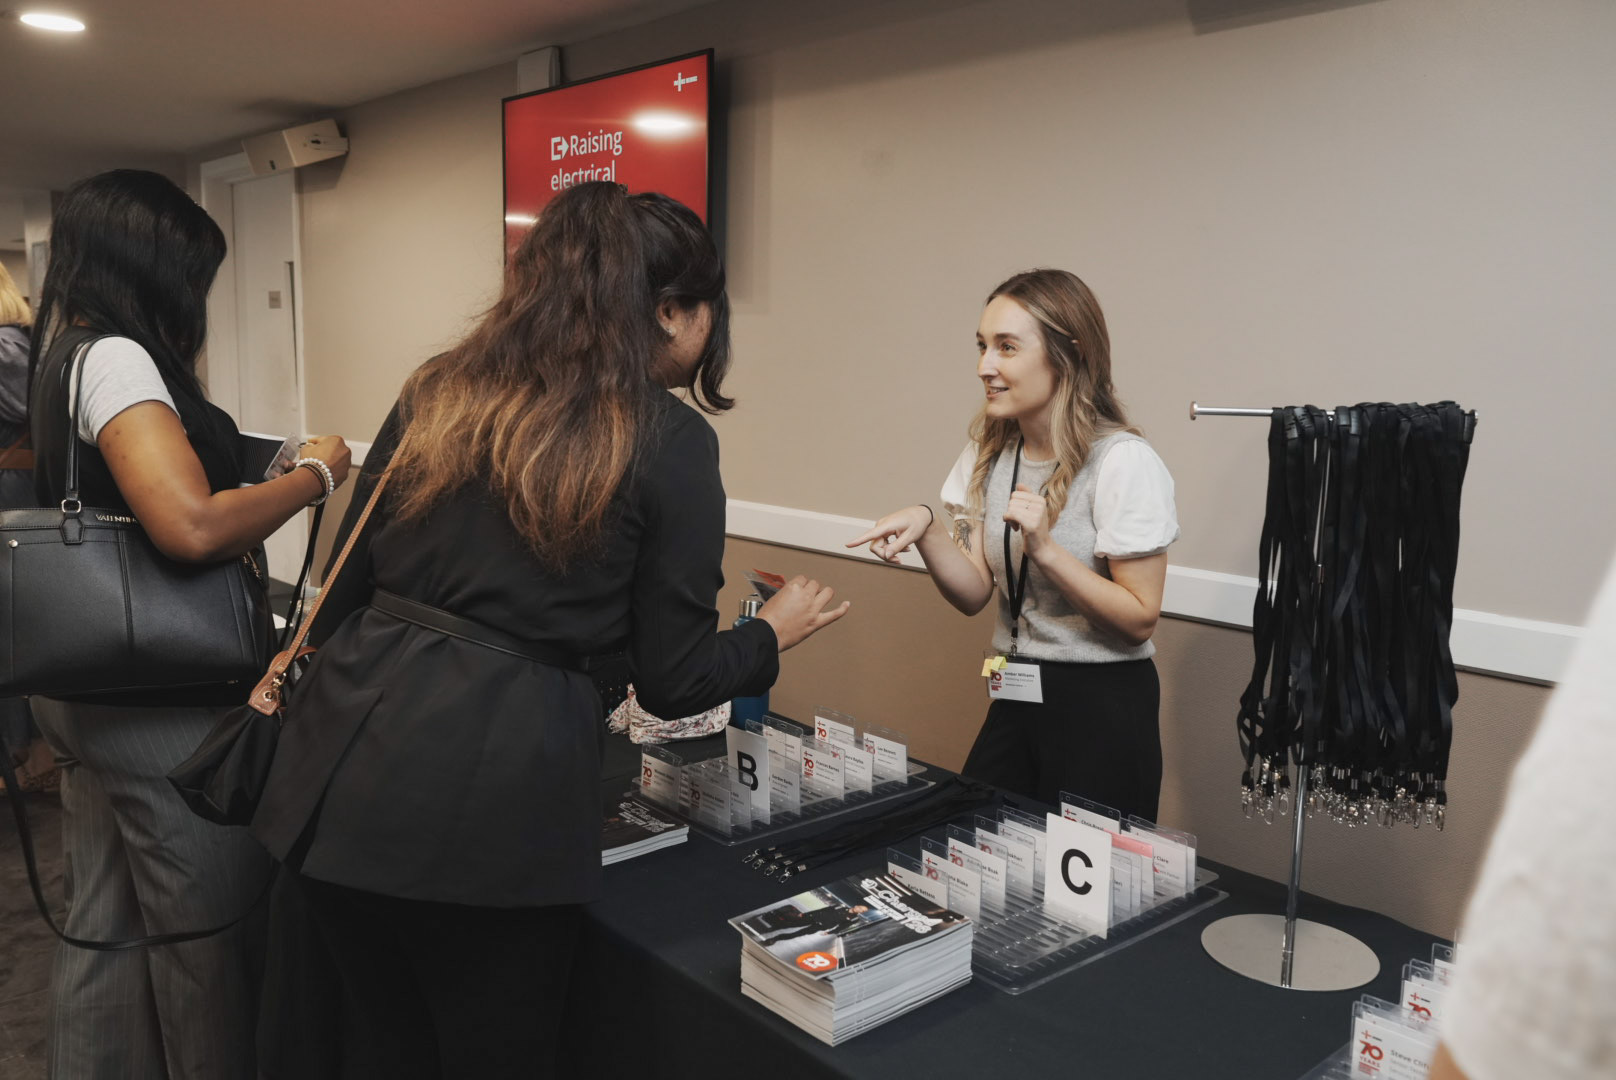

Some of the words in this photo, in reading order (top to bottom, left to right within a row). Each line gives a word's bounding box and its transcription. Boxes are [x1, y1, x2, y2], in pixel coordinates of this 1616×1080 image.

[570, 129, 623, 156] Raising
[551, 160, 616, 191] electrical
[817, 727, 827, 738] 70
[736, 750, 759, 792] B
[803, 757, 815, 769] 70
[1061, 848, 1093, 896] C
[1359, 1039, 1384, 1061] 70
[1390, 1049, 1412, 1063] Steve
[1359, 1056, 1381, 1068] YEARS
